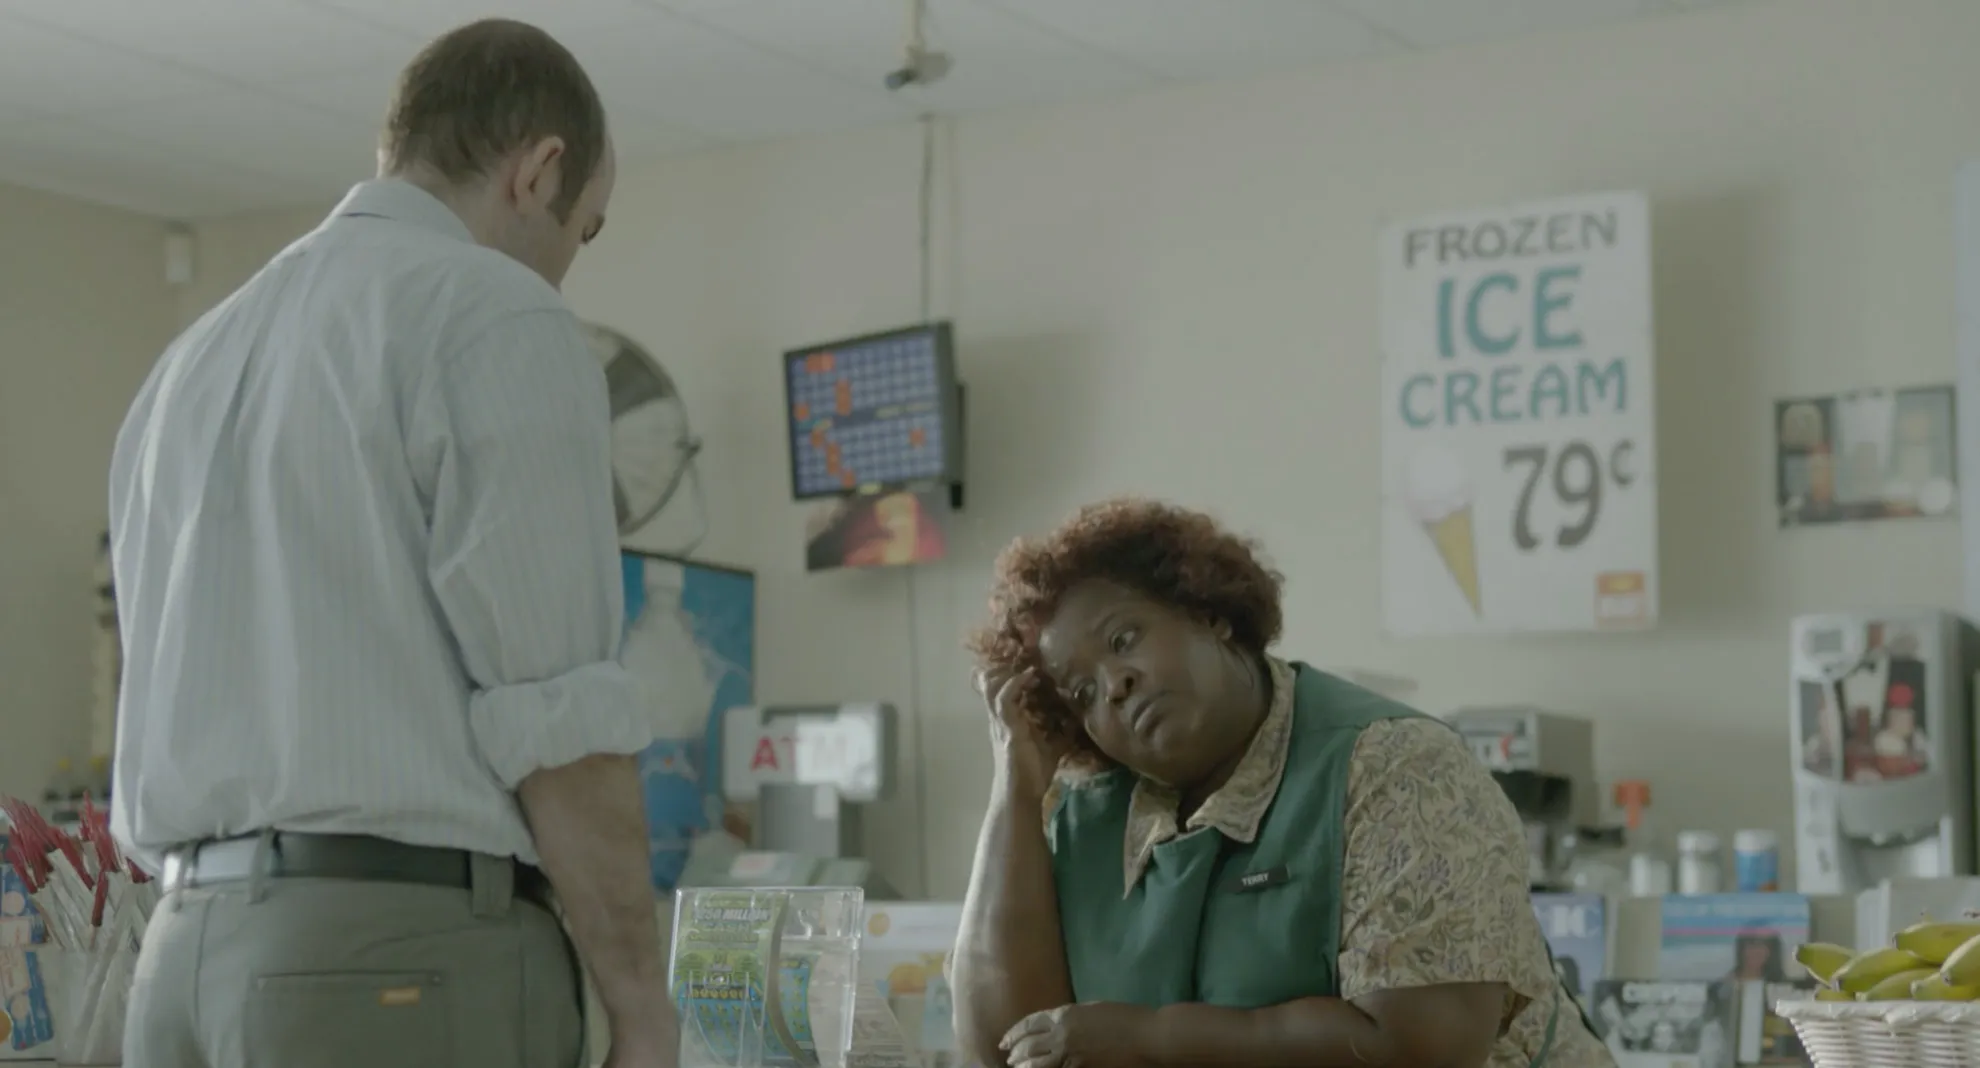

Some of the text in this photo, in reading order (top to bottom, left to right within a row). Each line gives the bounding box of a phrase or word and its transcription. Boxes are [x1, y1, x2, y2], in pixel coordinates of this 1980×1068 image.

[1404, 211, 1618, 268] FROZEN
[1437, 265, 1584, 359] ICE
[1400, 357, 1628, 428] CREAM
